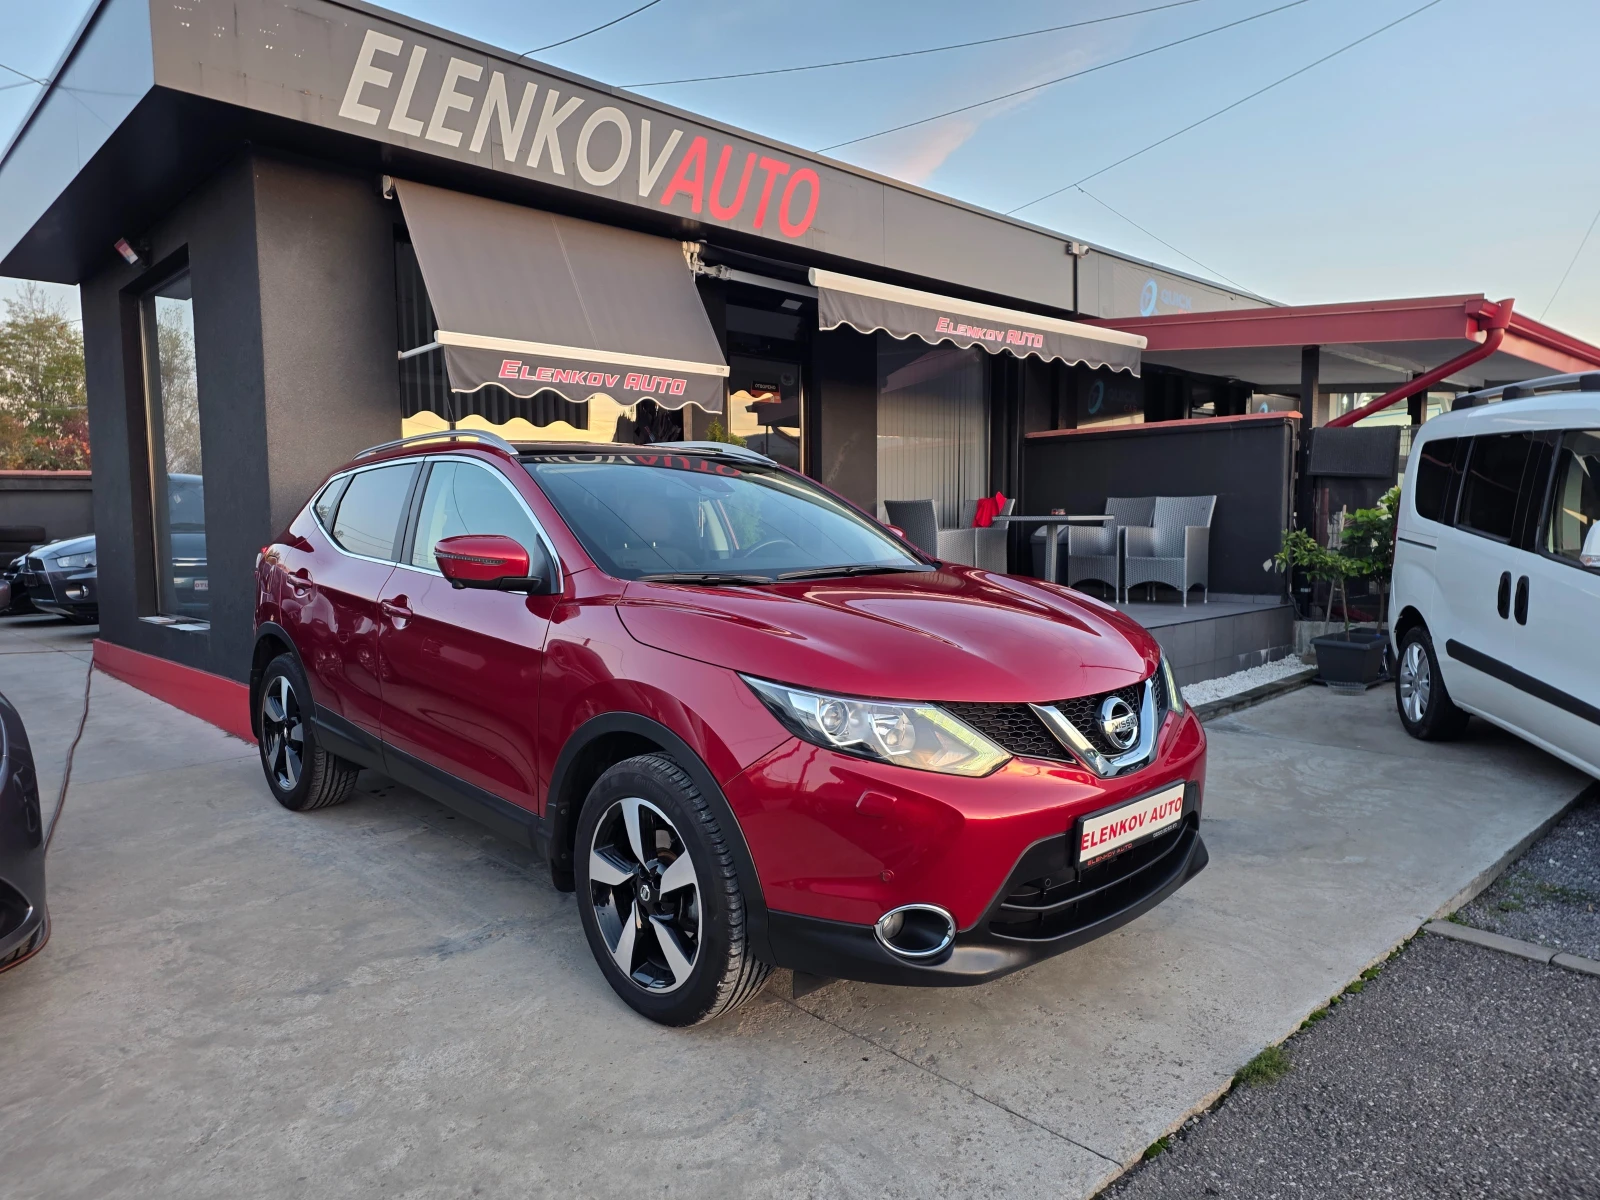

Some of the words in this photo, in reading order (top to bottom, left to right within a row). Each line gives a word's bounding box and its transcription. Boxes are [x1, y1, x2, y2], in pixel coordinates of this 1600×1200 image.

[1160, 288, 1192, 310] QUICK
[935, 316, 1005, 342] ELENKOV
[1006, 329, 1044, 348] AUTO
[498, 359, 620, 388] ELENKOV
[623, 372, 687, 396] AUTO
[1081, 811, 1147, 851] ELENKOV
[1149, 796, 1182, 823] AUTO
[1087, 849, 1116, 866] ELENKOV
[1116, 843, 1133, 855] AUTO
